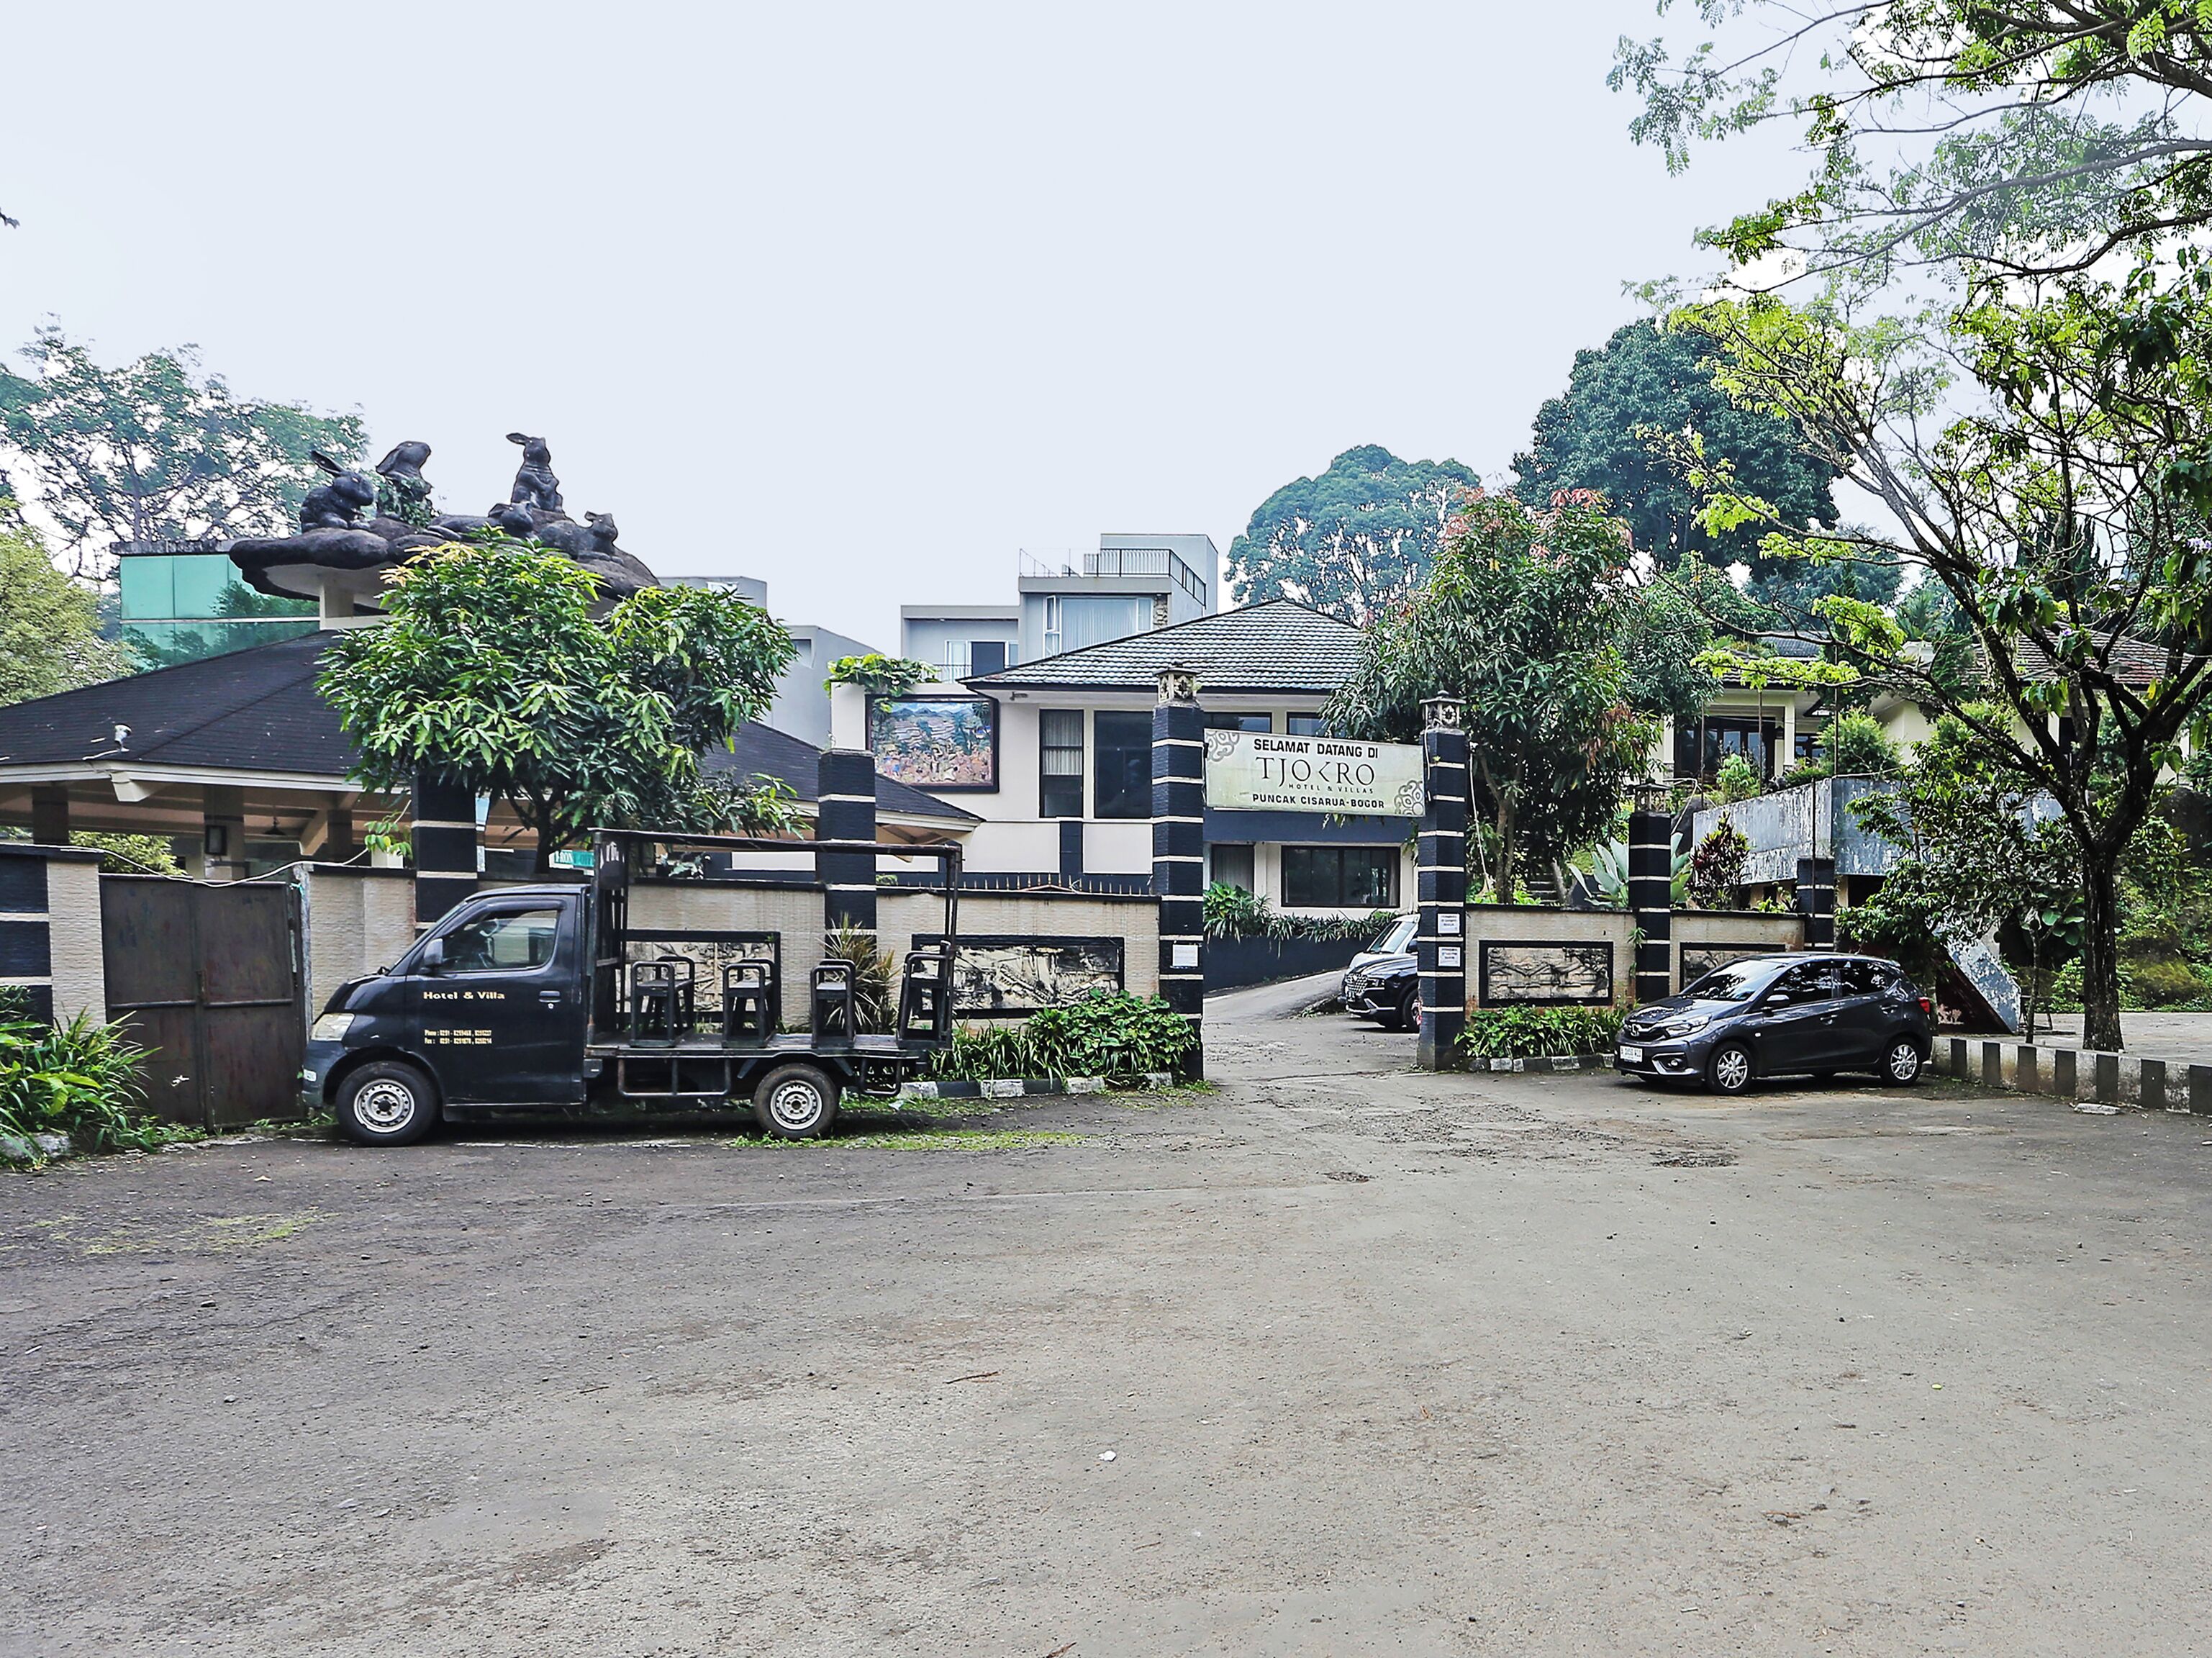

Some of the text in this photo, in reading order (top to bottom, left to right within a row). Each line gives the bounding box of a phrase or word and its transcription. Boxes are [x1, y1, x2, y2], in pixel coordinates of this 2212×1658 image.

[1254, 738, 1378, 758] SELAMAT DATANG DI
[1256, 756, 1374, 788] TJOKRO
[1338, 786, 1374, 794] VILLAS
[1252, 794, 1384, 809] PUNCAK CISARUA-BOGOR
